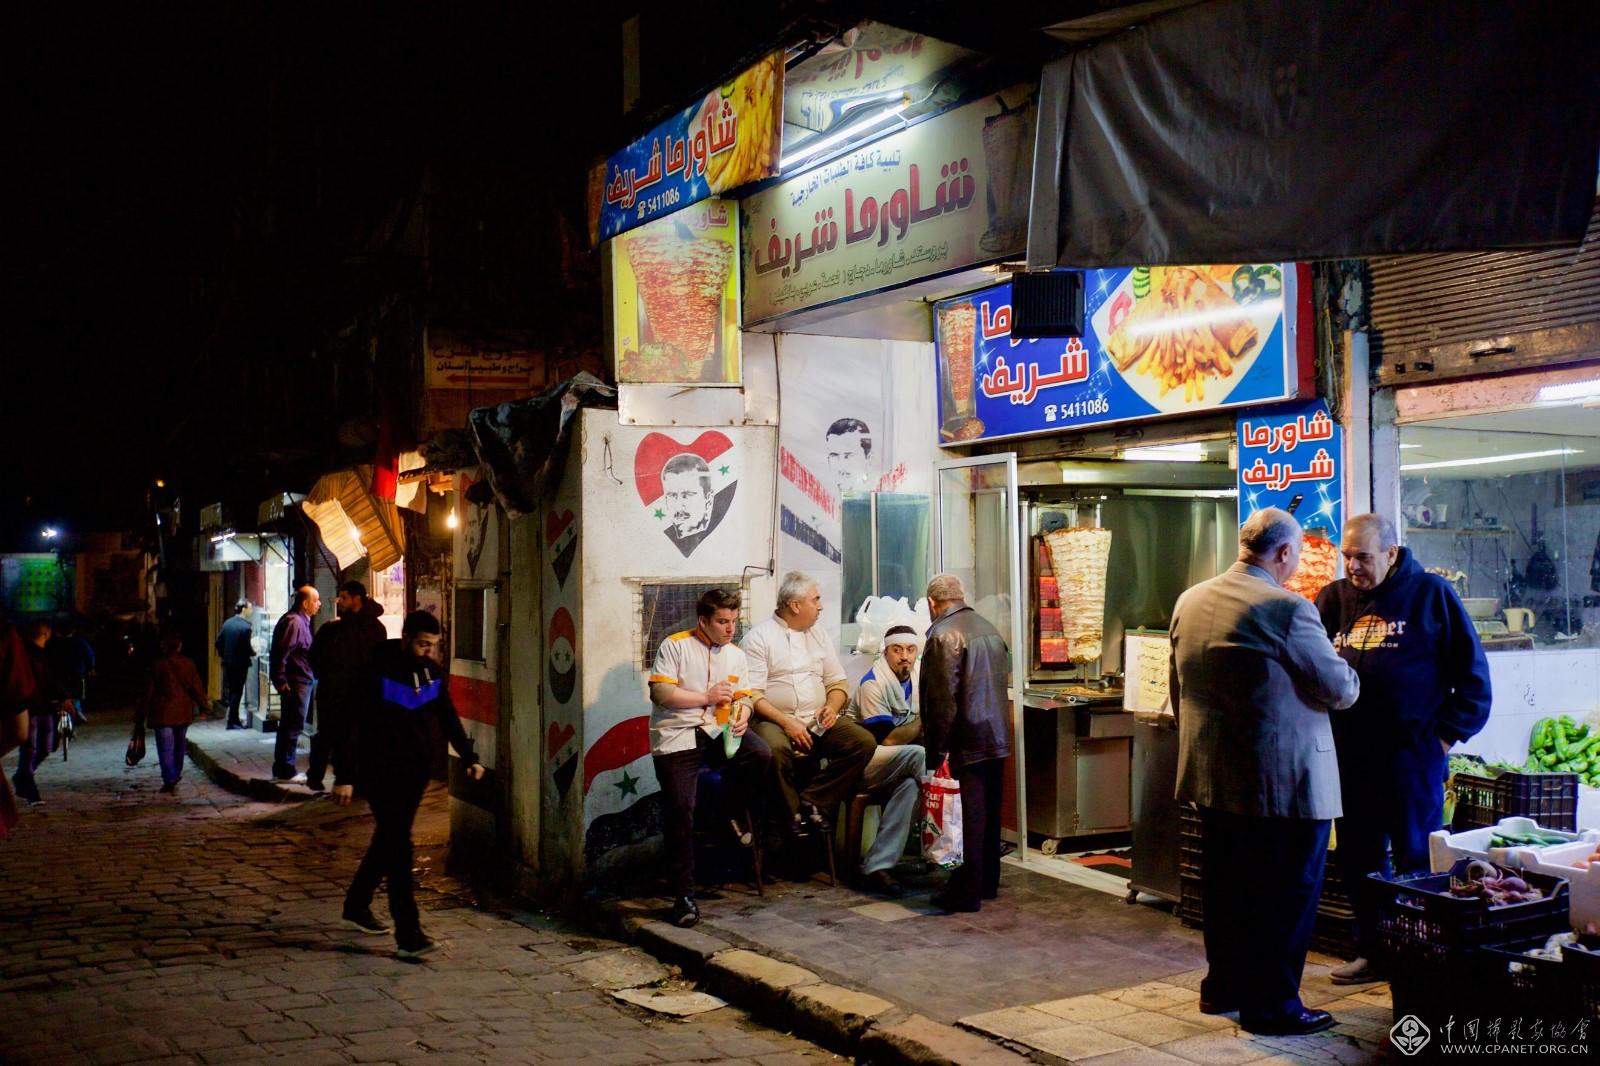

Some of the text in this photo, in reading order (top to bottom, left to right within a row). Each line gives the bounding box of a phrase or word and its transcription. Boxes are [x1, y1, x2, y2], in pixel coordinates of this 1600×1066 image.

[606, 99, 738, 209] شاورما شريف
[647, 187, 680, 215] 5411086
[754, 157, 976, 279] شاورما شريف
[981, 336, 1089, 406] شريف
[1060, 399, 1109, 420] 5411086
[1243, 410, 1333, 456] شاورما
[1242, 449, 1335, 491] شريف
